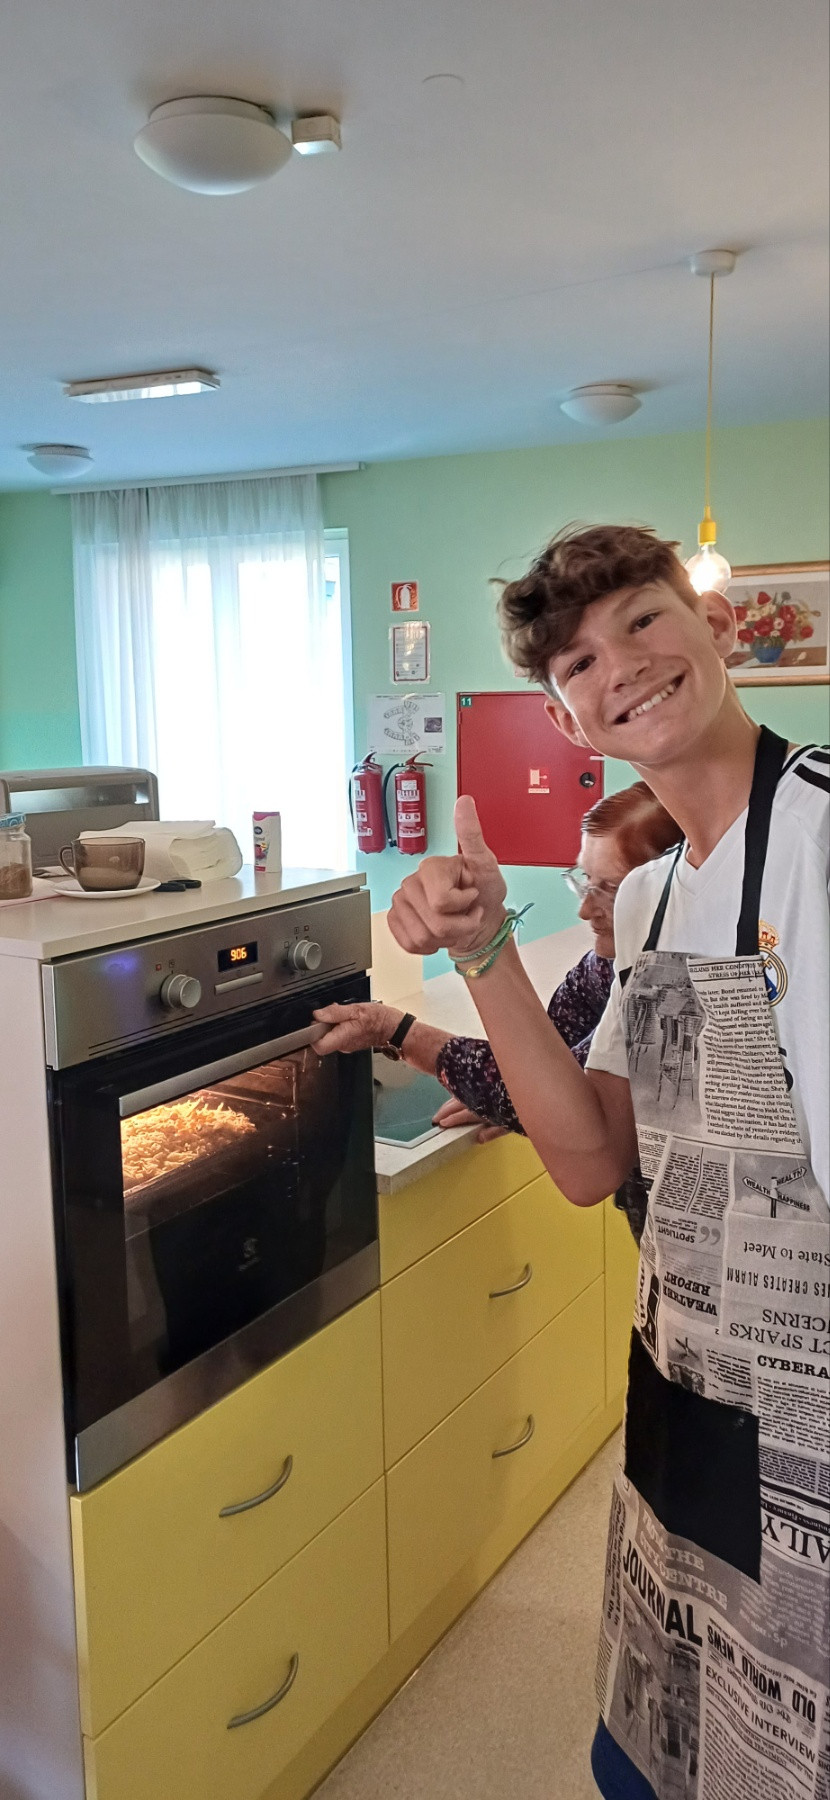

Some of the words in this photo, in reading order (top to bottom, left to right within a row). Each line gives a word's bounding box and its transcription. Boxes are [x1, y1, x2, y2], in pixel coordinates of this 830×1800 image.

[461, 697, 472, 706] 11
[744, 1028, 769, 1036] pumping
[746, 1178, 770, 1195] WEALTH
[777, 1168, 803, 1186] HEALTH
[778, 1194, 810, 1212] HAPPINESS
[658, 1225, 696, 1244] SPOTLIGHT
[744, 1242, 777, 1259] Meet
[780, 1248, 793, 1260] to
[798, 1250, 830, 1267] State
[664, 1271, 711, 1297] REPORT
[726, 1266, 759, 1286] ALARM
[763, 1274, 808, 1294] CREATES
[730, 1322, 803, 1350] SPARKS
[760, 1514, 830, 1564] AILY
[622, 1540, 702, 1648] JOURNAL
[660, 1561, 728, 1610] CENTRE
[606, 1600, 614, 1620] the
[707, 1624, 735, 1664] NEWS
[742, 1654, 782, 1702] WORLD
[706, 1665, 749, 1717] EXCLUSIVE
[752, 1711, 815, 1763] INTERVIEW
[792, 1690, 816, 1723] OLD
